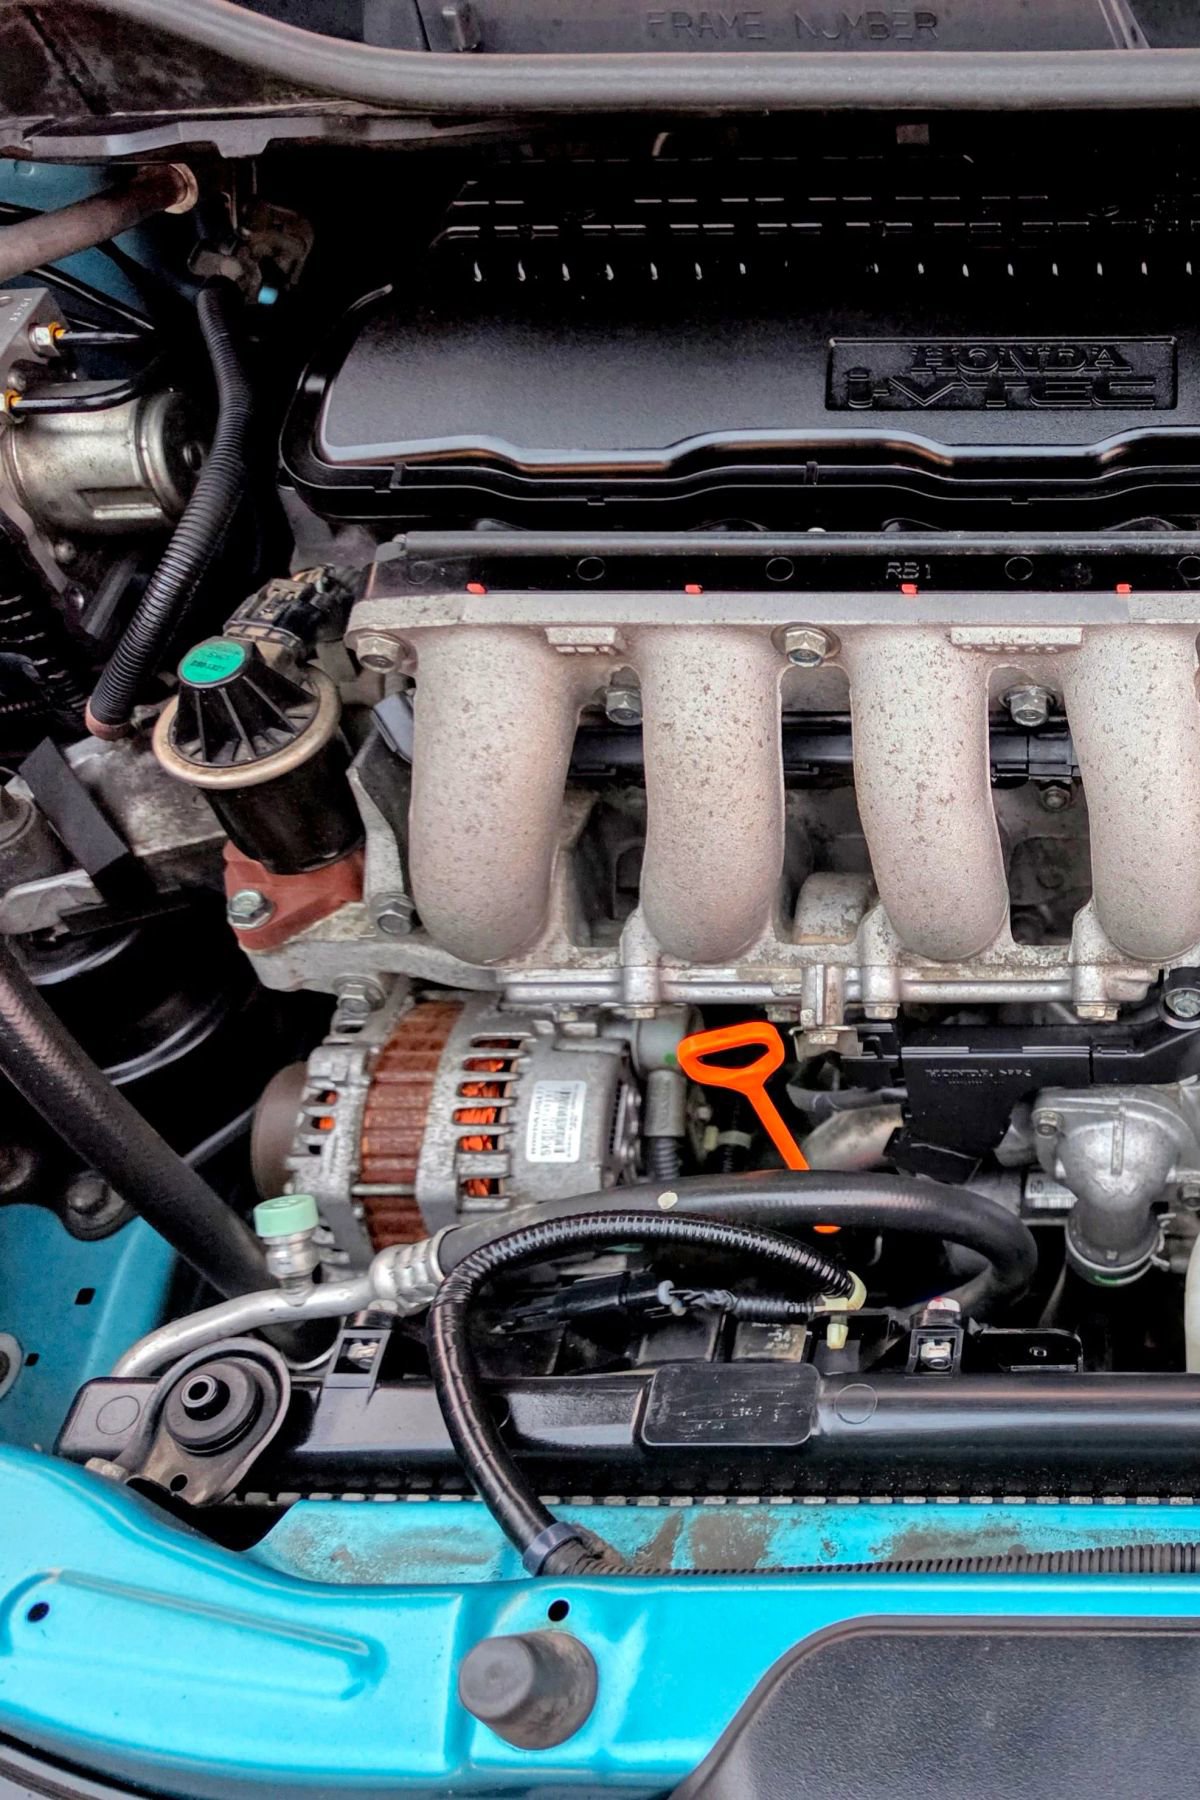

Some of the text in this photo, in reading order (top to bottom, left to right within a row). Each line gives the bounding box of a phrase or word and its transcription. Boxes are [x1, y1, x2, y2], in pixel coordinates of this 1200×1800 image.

[646, 10, 939, 41] FRAME NUMBER
[910, 347, 1133, 374] HONDA
